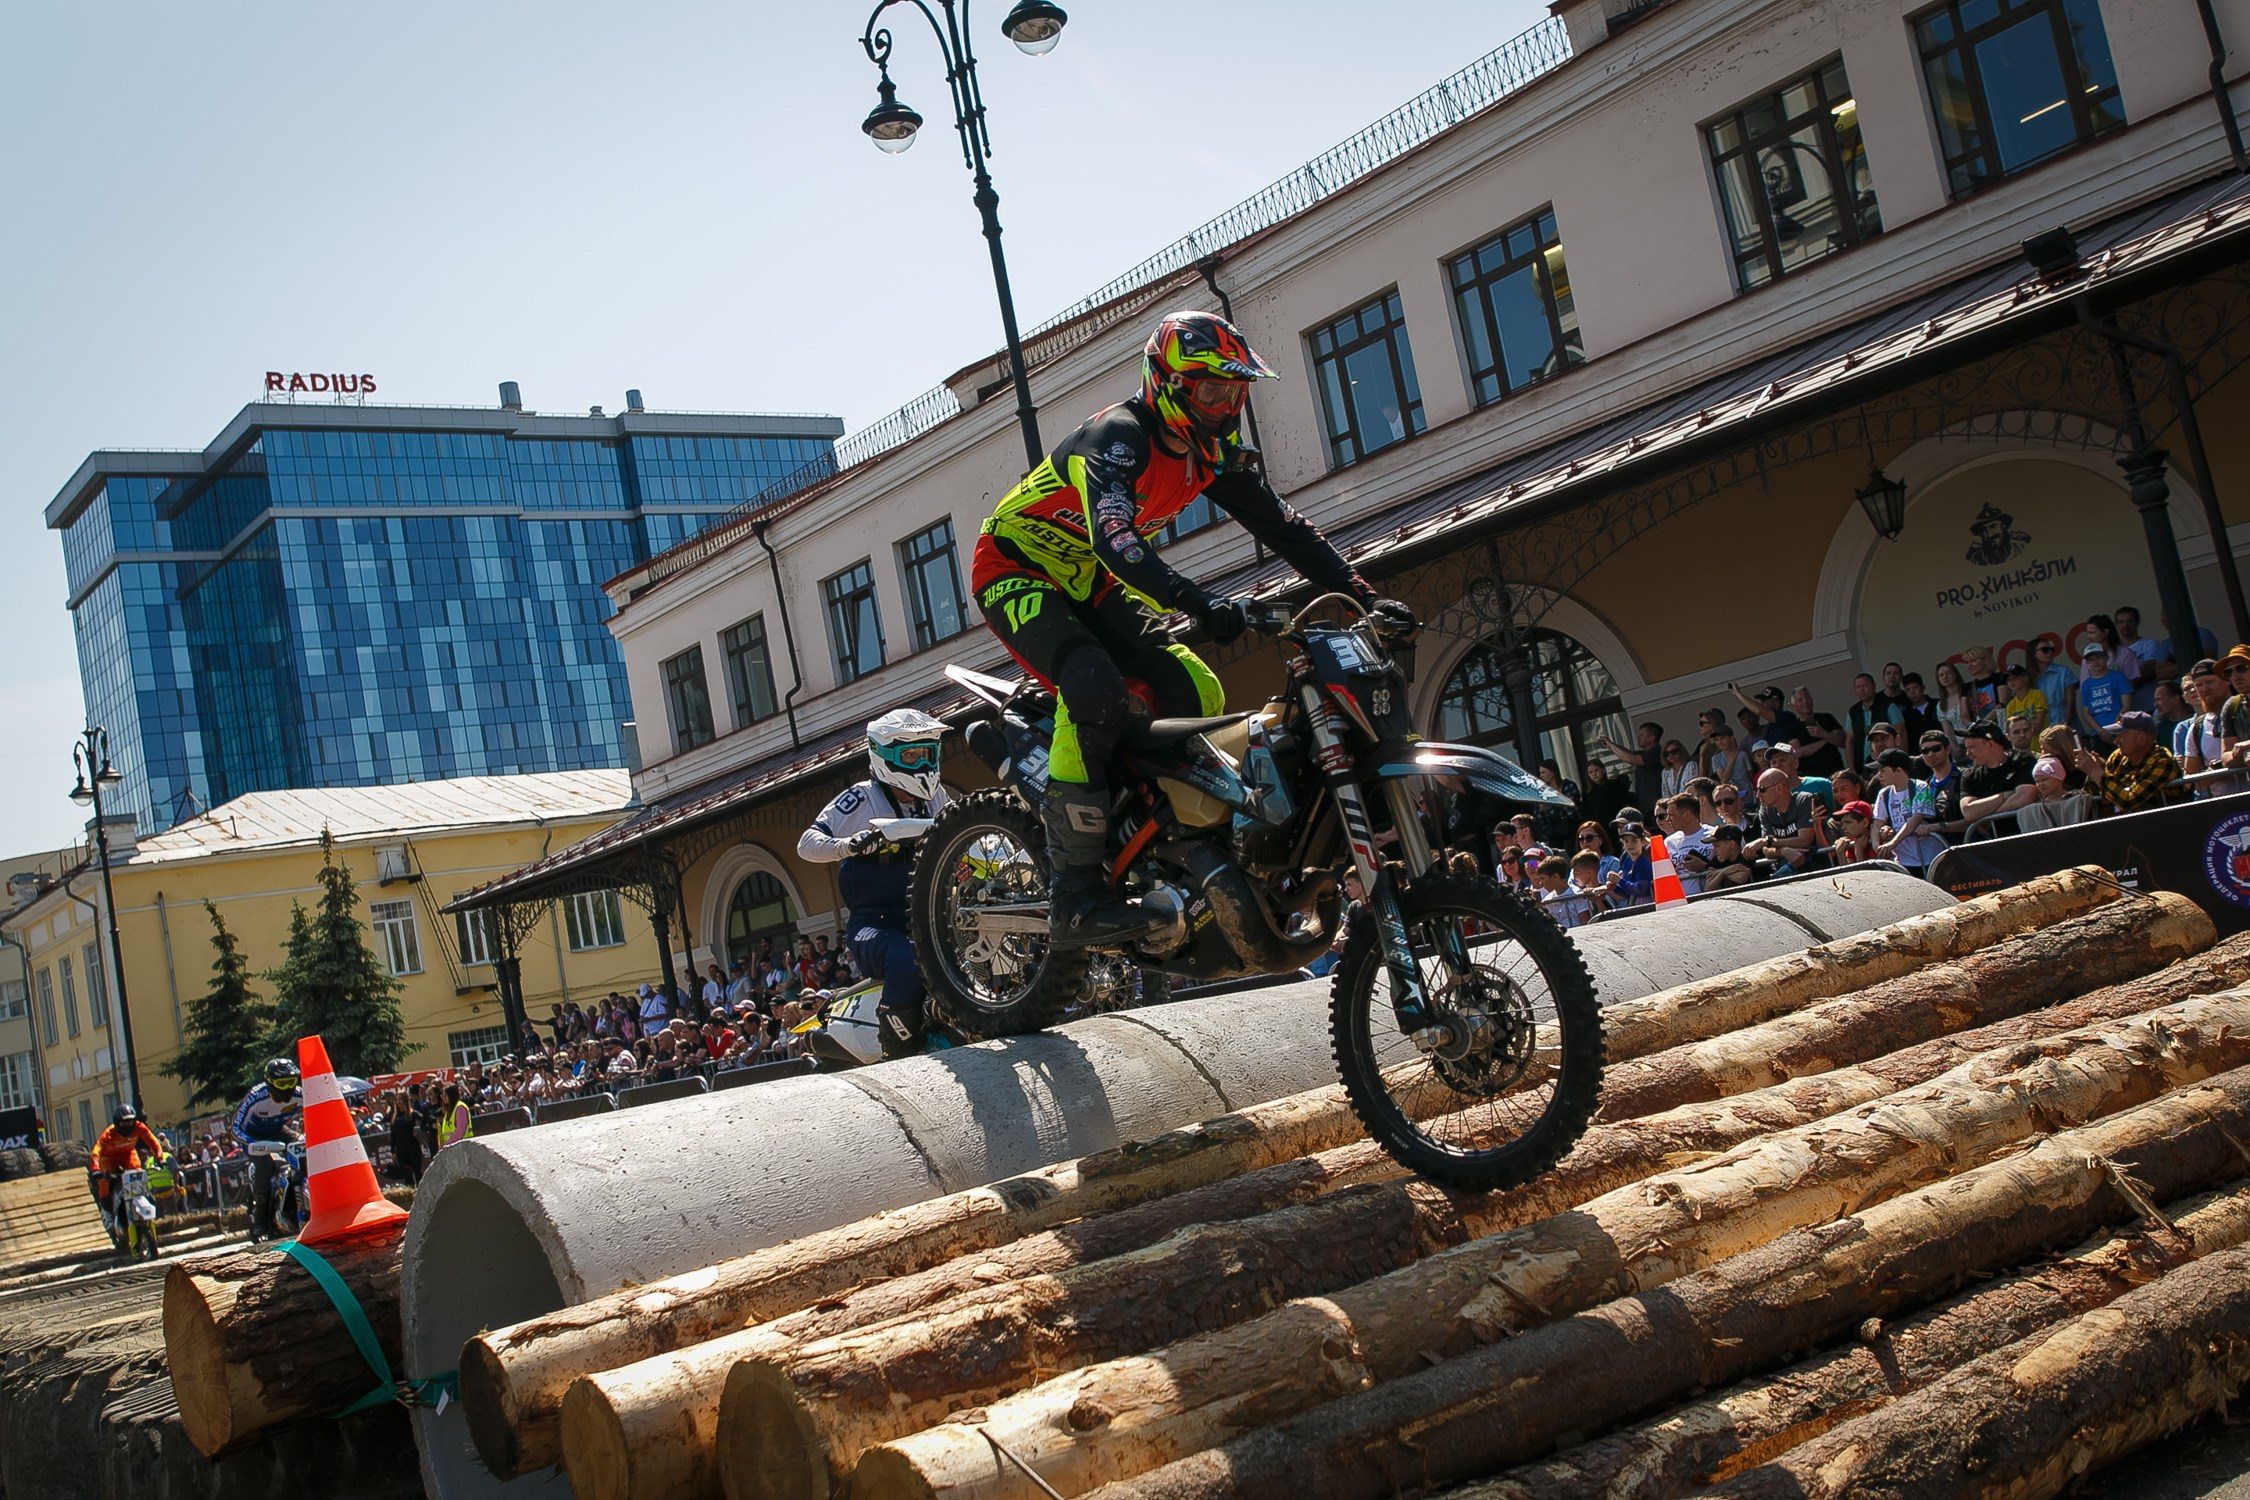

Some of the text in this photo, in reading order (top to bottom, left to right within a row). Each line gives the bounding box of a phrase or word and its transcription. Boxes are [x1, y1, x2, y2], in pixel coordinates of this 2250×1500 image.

[266, 371, 377, 393] RADIUS
[1003, 591, 1043, 634] 10
[1984, 591, 2041, 614] NOVIKOV
[2091, 695, 2113, 707] WAVE
[2092, 688, 2109, 698] SEA
[2206, 814, 2250, 854] МОТОЦИКЛЕТ
[1951, 879, 2002, 891] ФЕСТИВАЛЬ
[2206, 856, 2239, 901] ФЕДЕРАЦИЯ
